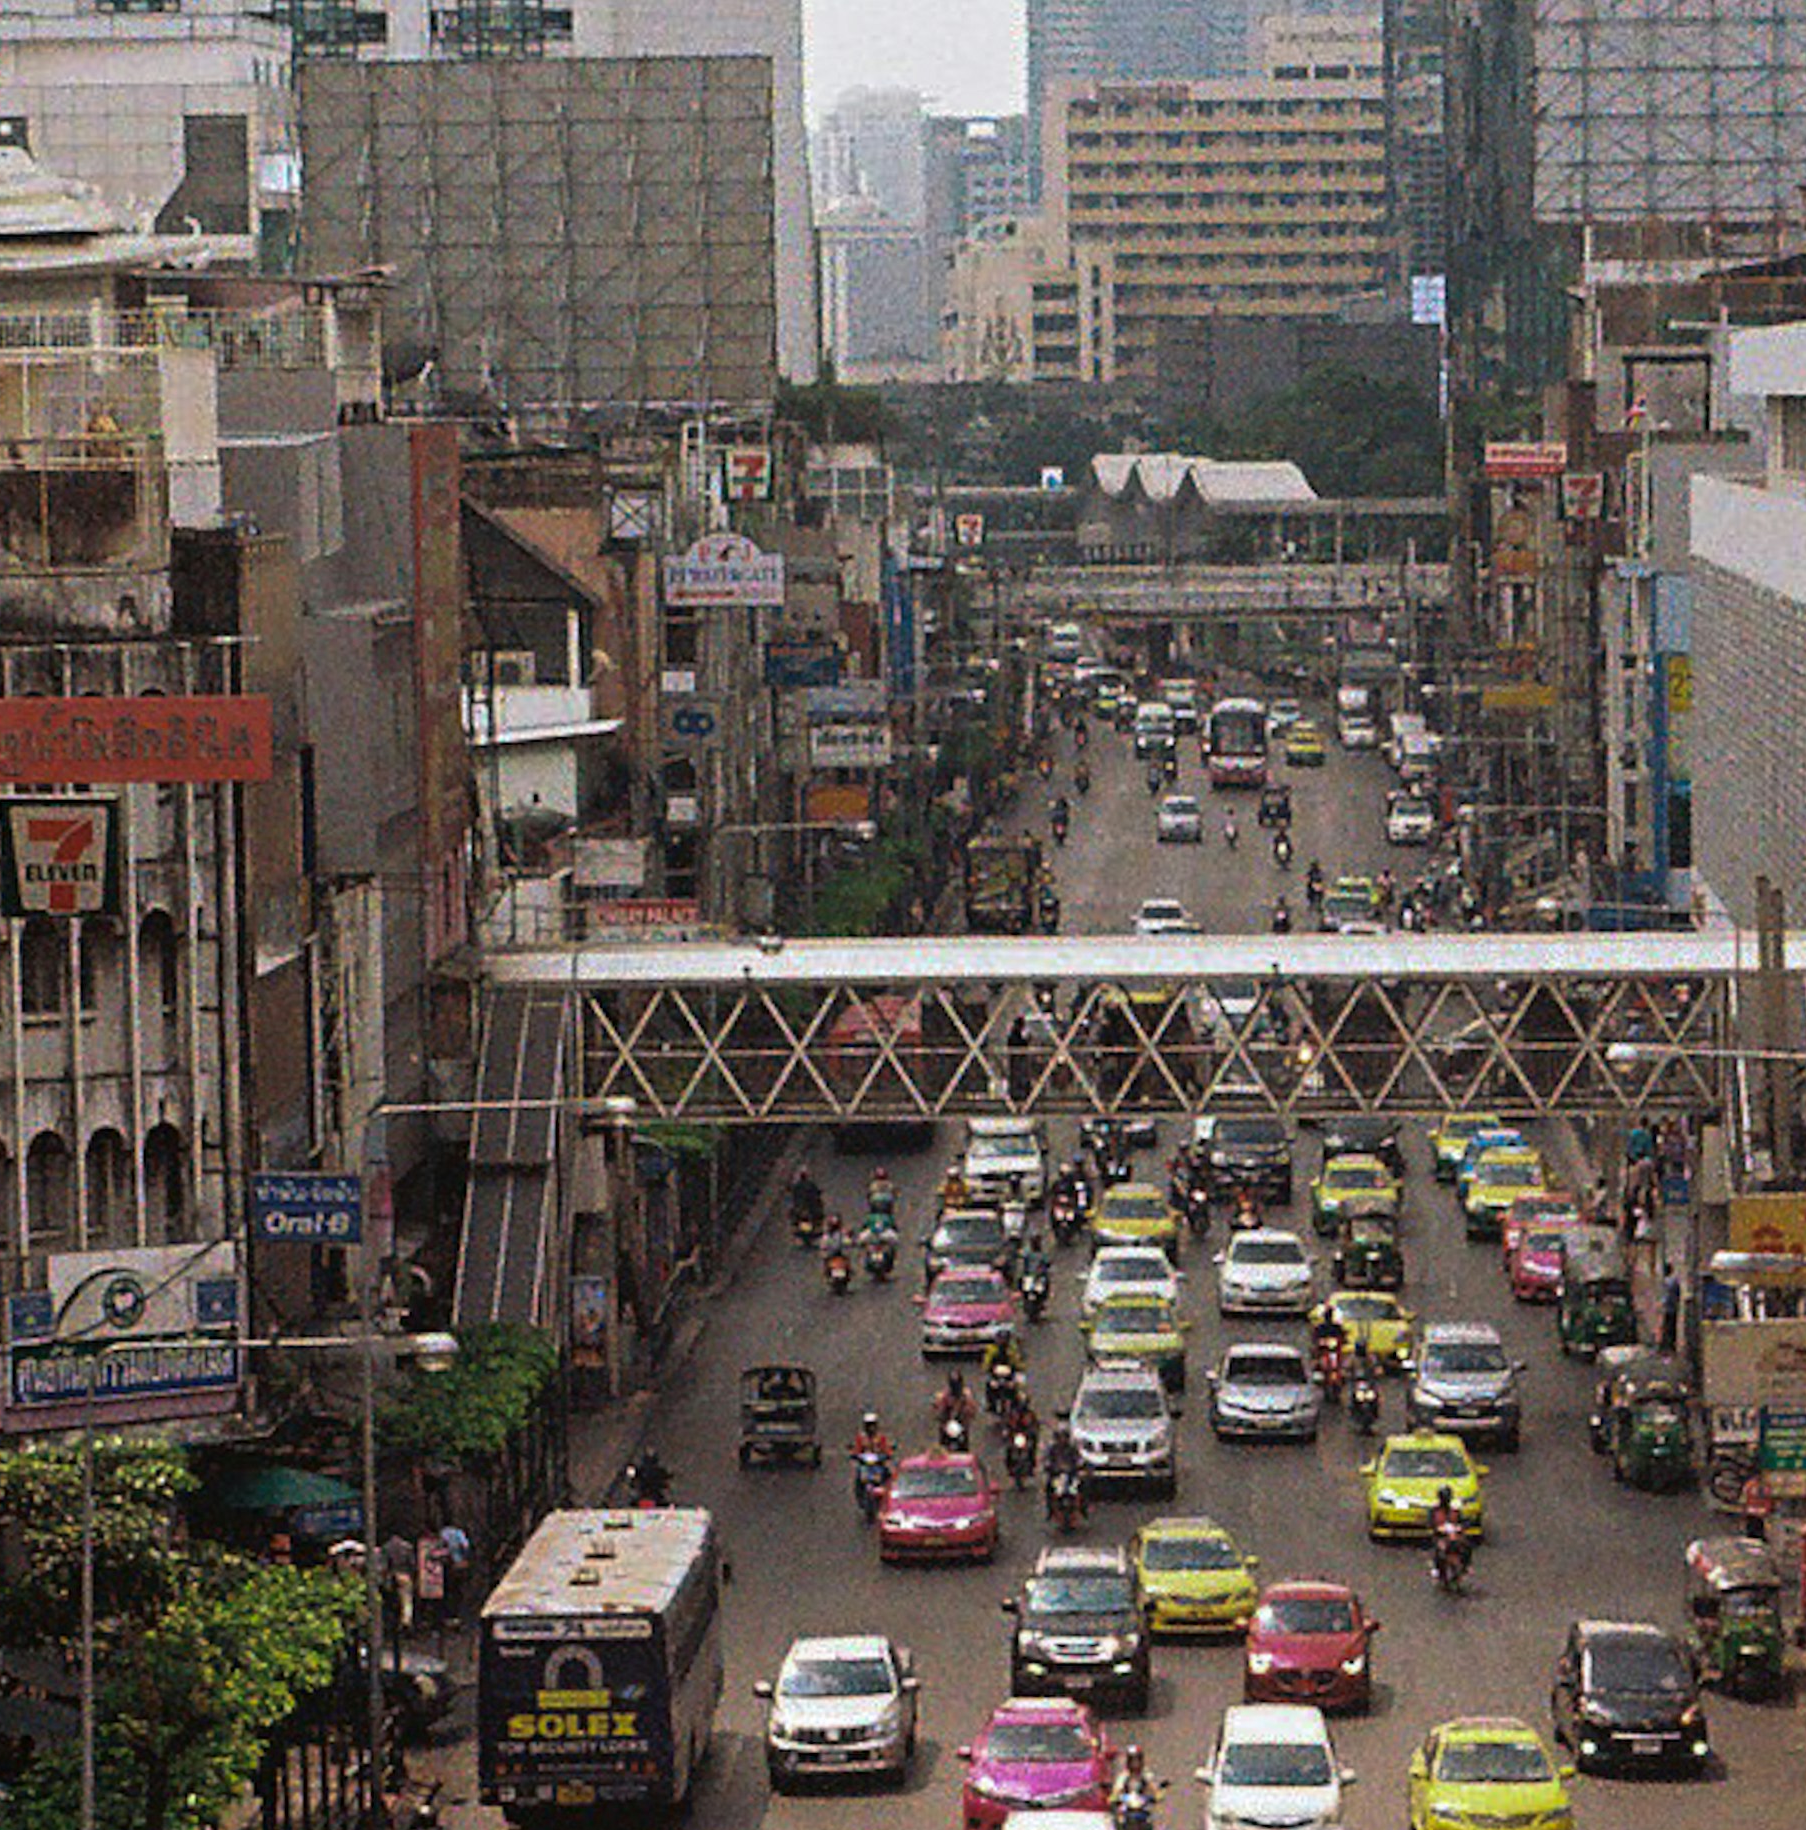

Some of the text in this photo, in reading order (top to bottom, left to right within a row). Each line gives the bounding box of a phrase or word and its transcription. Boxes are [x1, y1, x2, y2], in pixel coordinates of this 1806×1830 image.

[25, 862, 98, 883] ELEVEN
[264, 1210, 352, 1236] Oral-B
[507, 1712, 639, 1739] SOLEX
